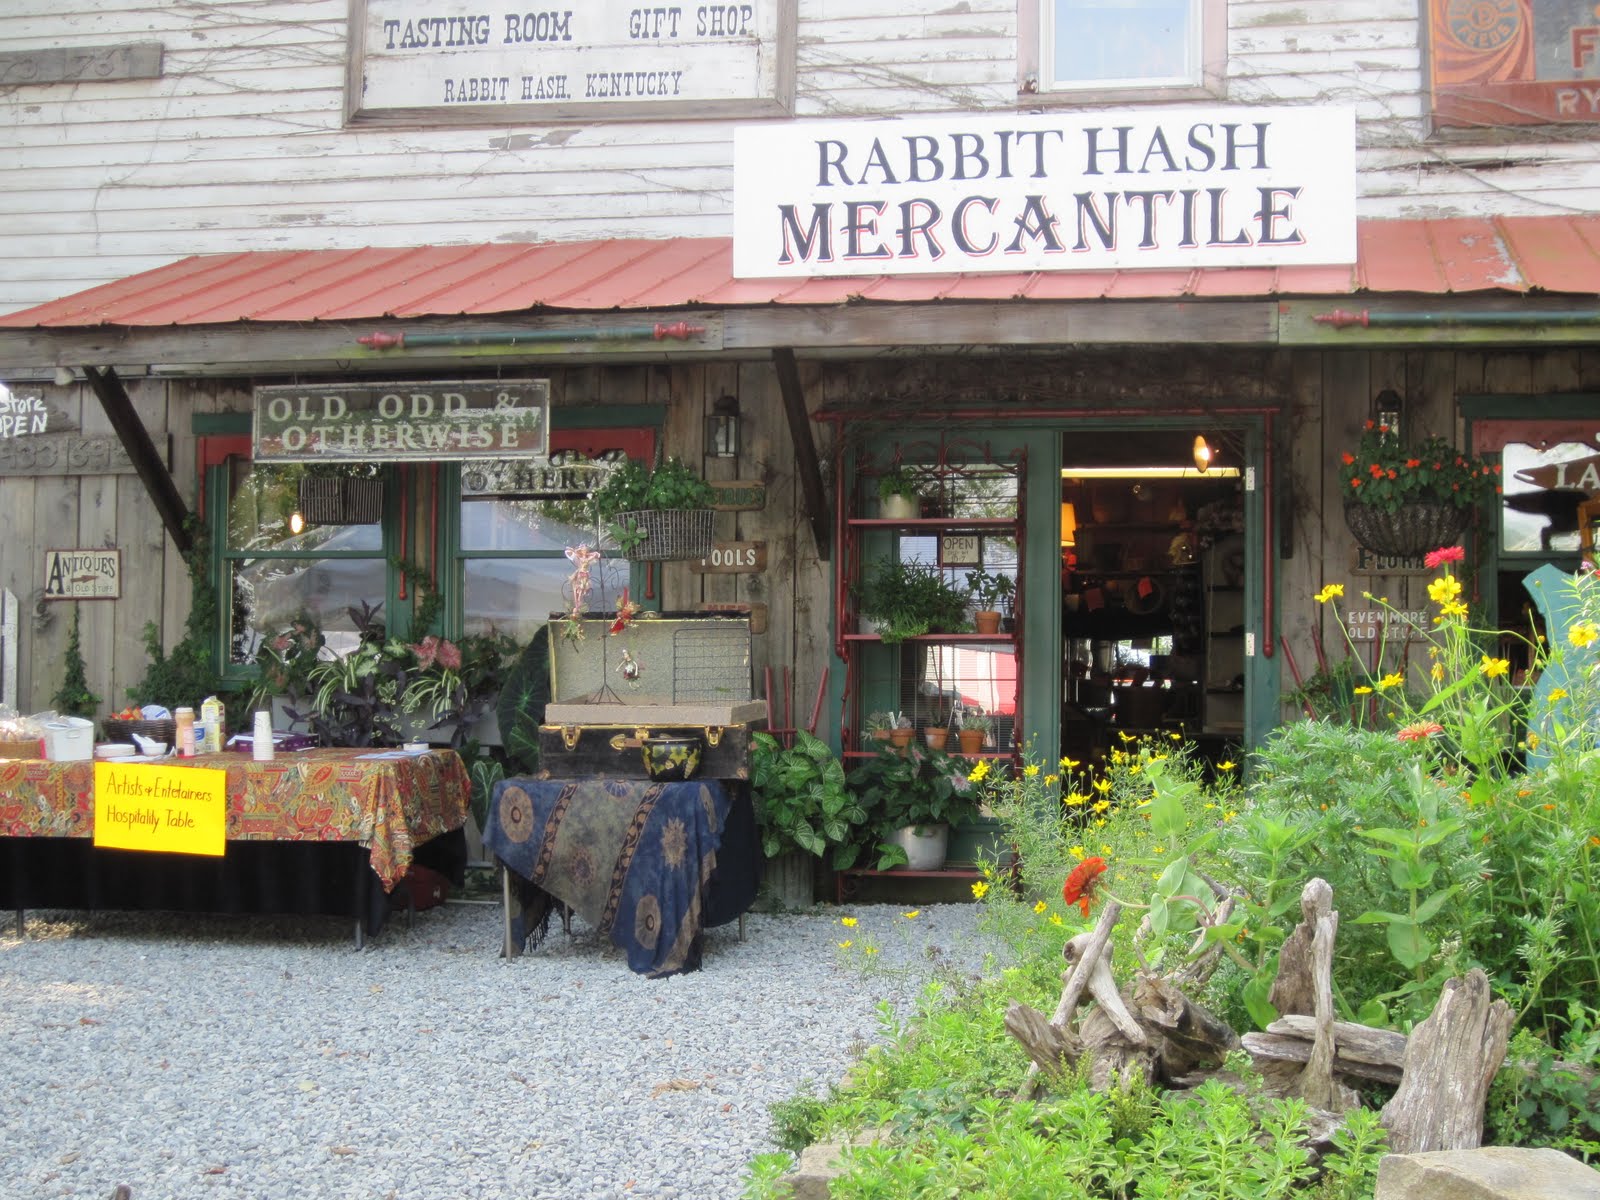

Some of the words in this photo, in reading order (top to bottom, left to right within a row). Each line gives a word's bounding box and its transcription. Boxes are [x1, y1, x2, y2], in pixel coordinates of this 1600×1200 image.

[383, 15, 490, 49] TASTING
[503, 11, 573, 44] ROOM
[629, 7, 682, 38] GIFT
[696, 5, 753, 36] SHOP
[444, 77, 509, 102] RABBIT
[585, 71, 682, 97] KENTUCKY
[815, 129, 1064, 187] RABBIT
[1082, 122, 1272, 175] HASH
[777, 186, 1308, 265] MERCANTILE
[378, 392, 468, 418] ODD
[494, 392, 520, 421] &
[0, 413, 48, 438] PEN
[281, 422, 519, 450] OTHERWISE
[943, 537, 974, 550] OPEN
[45, 552, 115, 594] ANTIQUES
[1348, 611, 1385, 623] EVEN
[1390, 611, 1427, 624] MORE
[1348, 627, 1376, 639] OLD
[106, 771, 143, 797] Artists
[106, 804, 160, 834] Hospitality
[165, 808, 196, 828] Table
